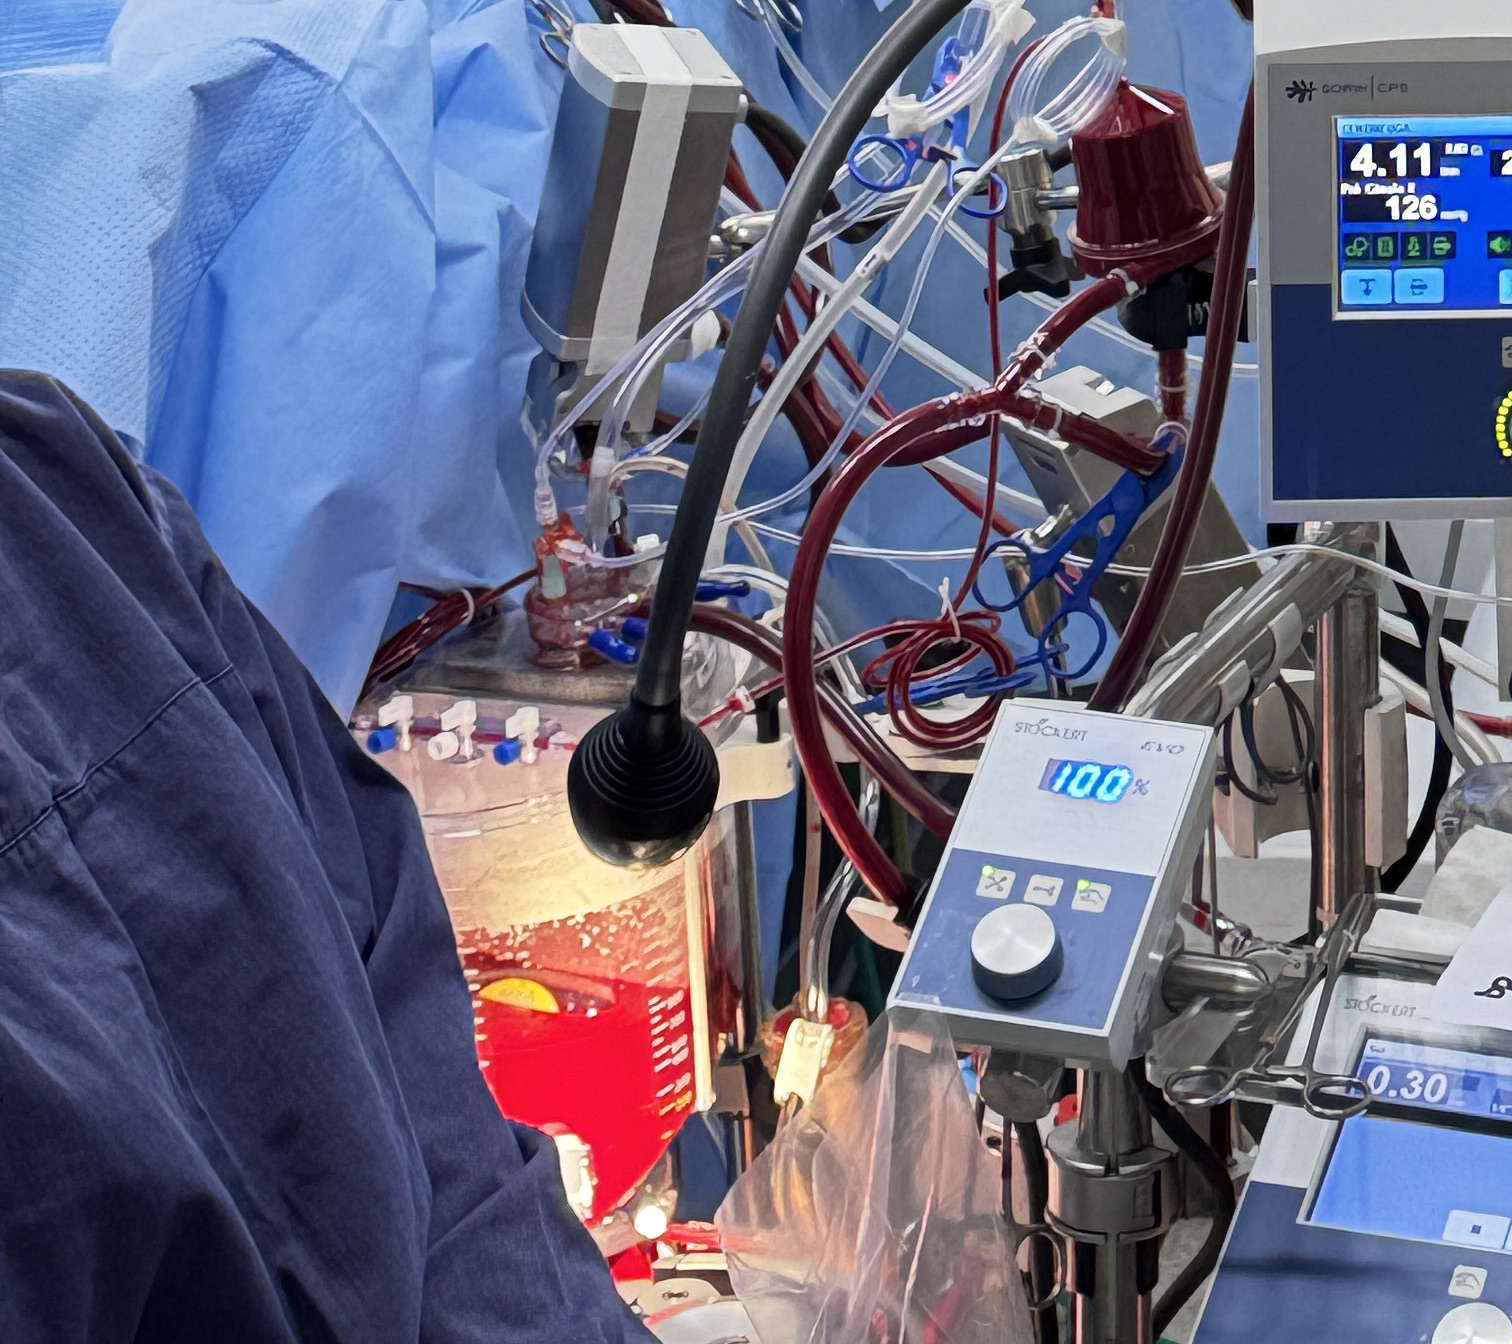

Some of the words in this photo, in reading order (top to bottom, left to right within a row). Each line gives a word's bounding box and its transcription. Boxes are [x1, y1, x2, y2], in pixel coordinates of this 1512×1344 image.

[1350, 142, 1431, 178] 4.11
[1385, 194, 1438, 221] 126
[1051, 762, 1133, 802] 100
[1367, 1065, 1448, 1103] 0.30
